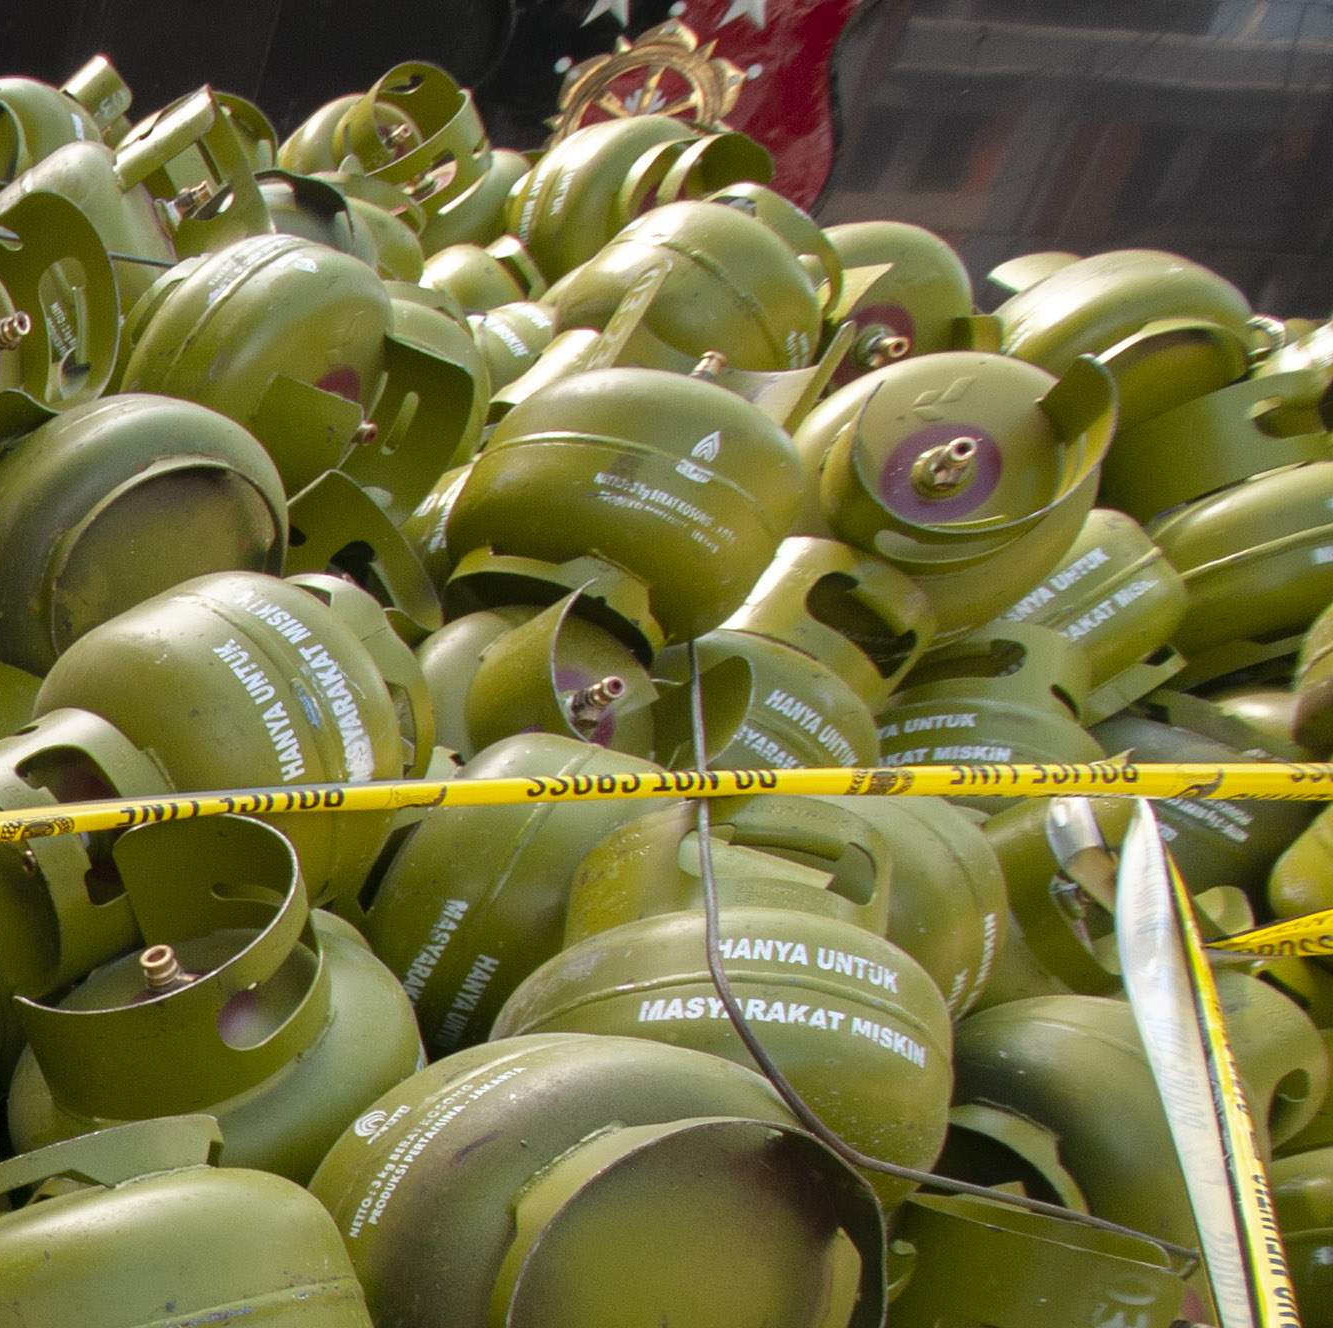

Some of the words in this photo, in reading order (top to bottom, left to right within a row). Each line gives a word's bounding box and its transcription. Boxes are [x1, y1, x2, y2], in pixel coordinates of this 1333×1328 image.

[213, 638, 277, 706] UNTUK
[764, 689, 820, 736] HANYA
[262, 697, 305, 781] HANYA
[526, 772, 642, 798] CROSS
[651, 770, 720, 794] NOT
[734, 768, 779, 791] DO
[717, 937, 810, 967] HANYA
[816, 946, 901, 994] UNTUK
[850, 1016, 927, 1069] MISKIN
[368, 1166, 411, 1225] PRODUKSI
[406, 1107, 465, 1168] PERTAMINA
[470, 1066, 528, 1106] JAKARTA
[350, 1195, 374, 1238] NETTO
